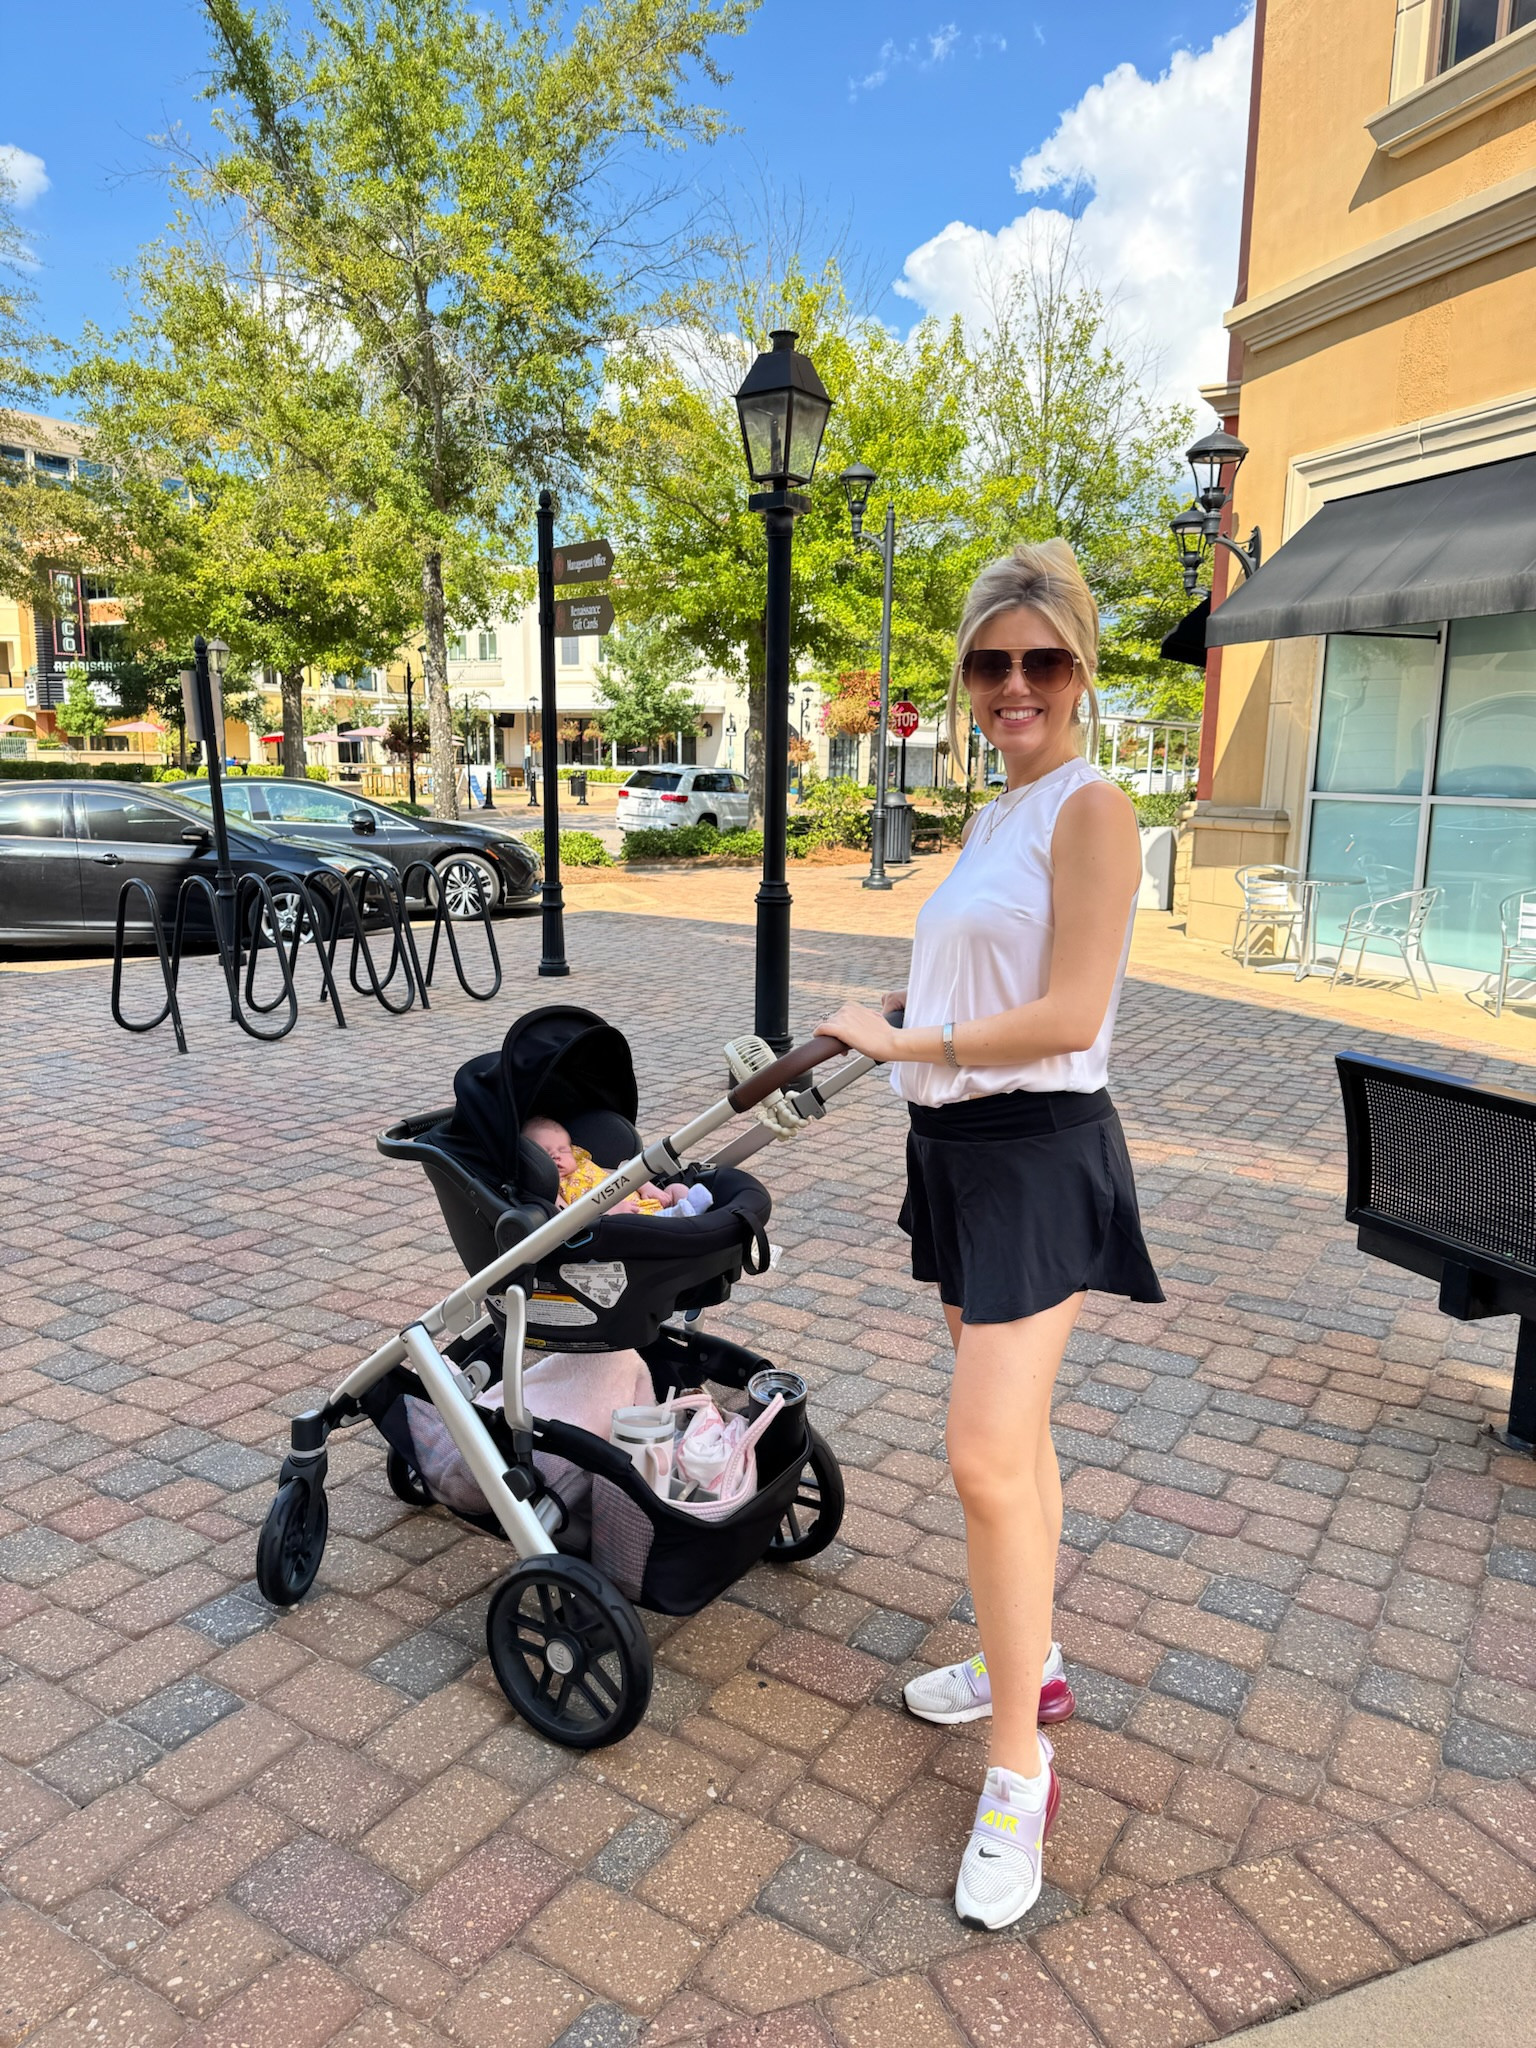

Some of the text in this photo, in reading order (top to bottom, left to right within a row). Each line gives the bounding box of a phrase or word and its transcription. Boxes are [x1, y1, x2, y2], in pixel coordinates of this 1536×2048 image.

[567, 552, 606, 573] Management Office
[56, 574, 76, 652] MACO
[570, 604, 601, 617] Renaissance
[572, 617, 598, 630] Gift Cards
[591, 1175, 630, 1205] VISTA
[980, 1808, 1019, 1836] AIR
